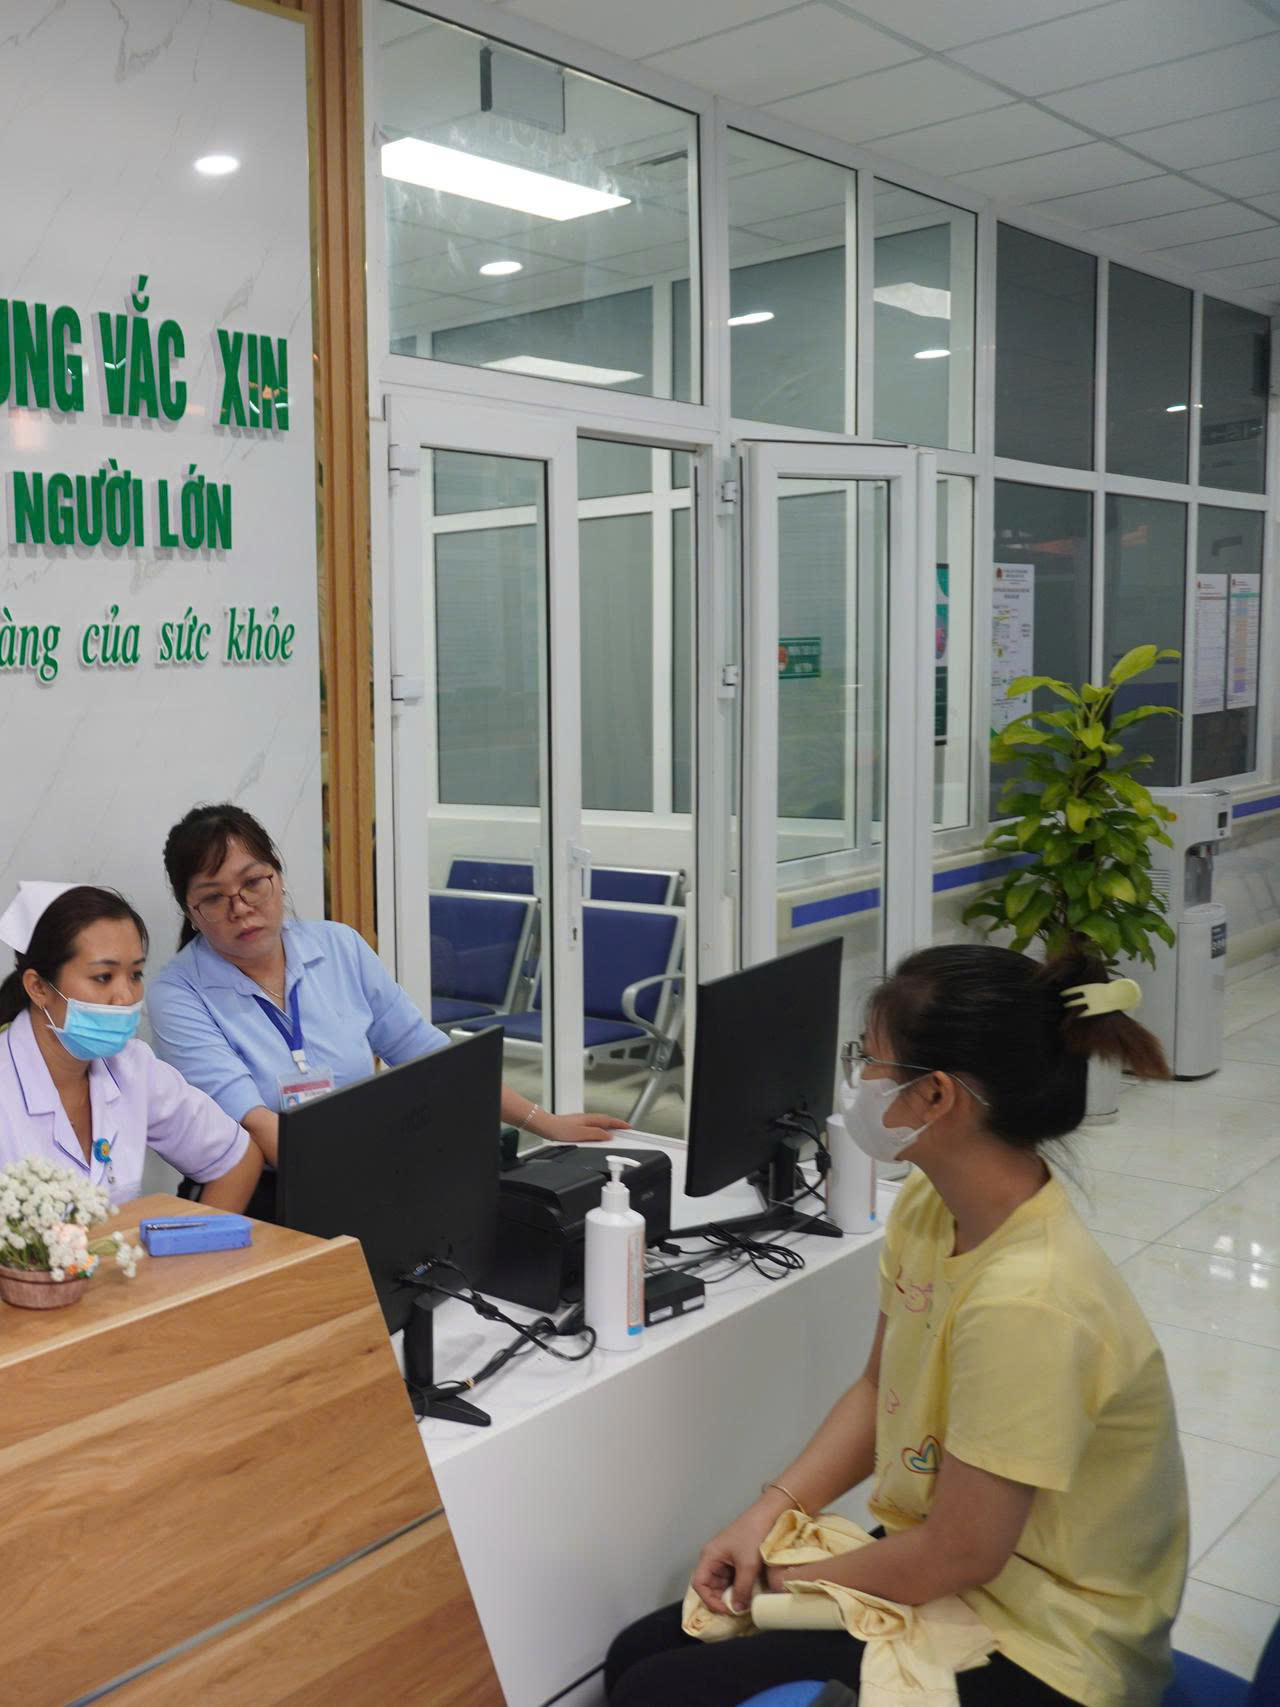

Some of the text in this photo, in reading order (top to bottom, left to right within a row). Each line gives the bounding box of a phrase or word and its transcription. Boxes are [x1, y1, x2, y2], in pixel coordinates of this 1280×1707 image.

[98, 274, 188, 423] VẮC
[216, 328, 290, 433] XIN
[12, 457, 145, 549] NGƯỜI
[158, 463, 233, 551] LỚN
[81, 604, 142, 667] của
[160, 607, 213, 663] sức
[226, 606, 297, 662] khỏe
